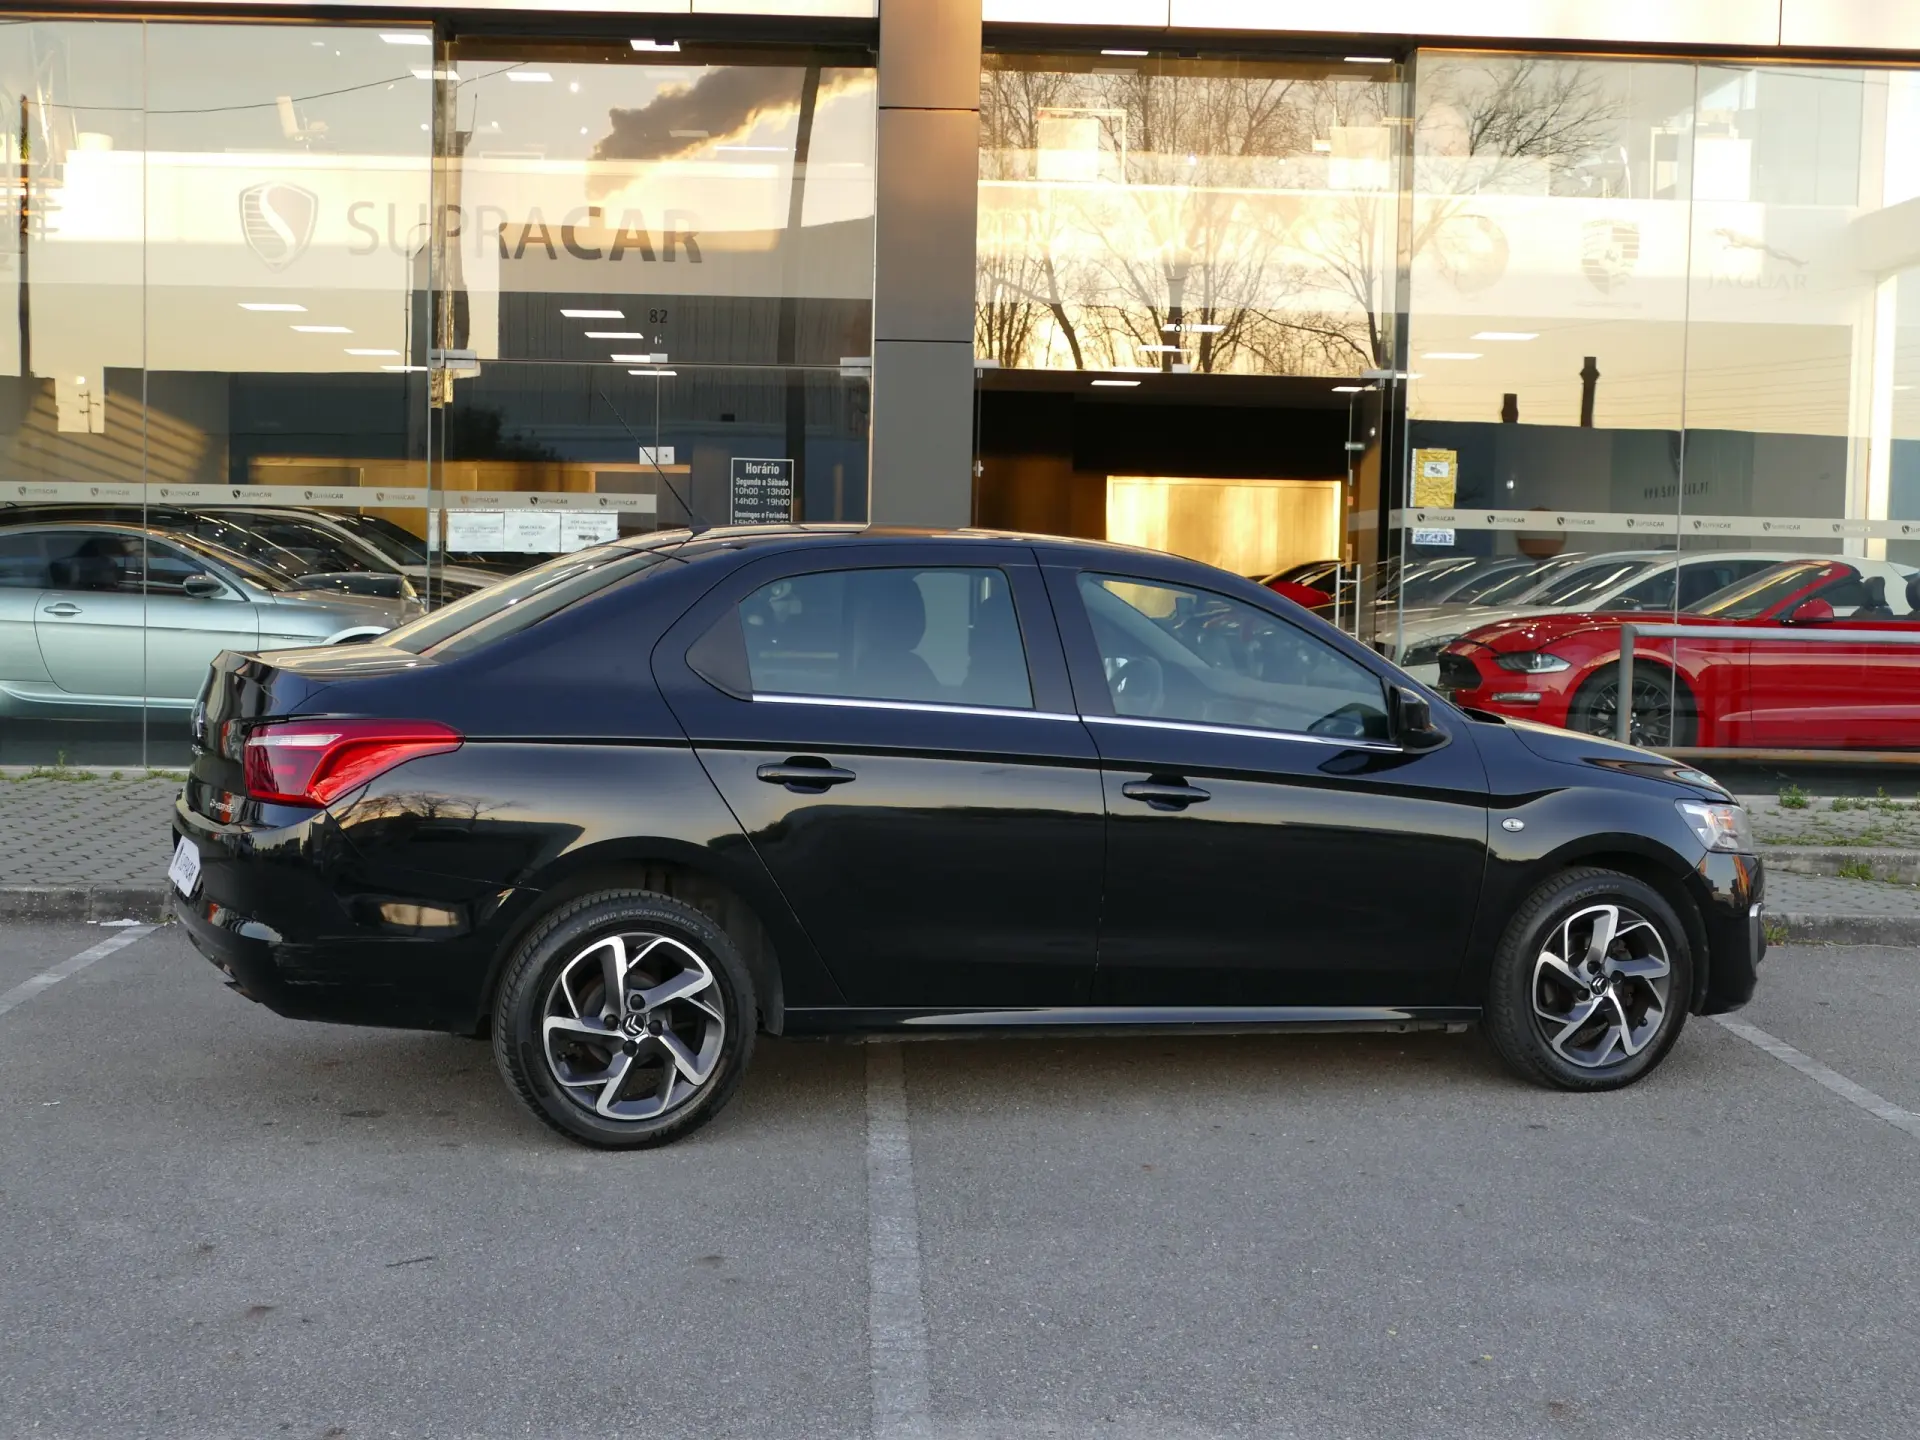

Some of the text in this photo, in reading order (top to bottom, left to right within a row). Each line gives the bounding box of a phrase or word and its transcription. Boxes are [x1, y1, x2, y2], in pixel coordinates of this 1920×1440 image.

[347, 200, 703, 263] SUPRACAR
[1706, 270, 1808, 291] JAGUAR
[649, 309, 668, 324] 82
[745, 462, 780, 474] Horário
[735, 477, 761, 487] Segunda
[767, 477, 789, 487] Sábado
[735, 487, 758, 495] 10h00
[766, 488, 790, 496] 13h00
[735, 497, 758, 505] 14h00
[766, 498, 790, 506] 19h00
[588, 909, 700, 931] ROAD PERFORMANCE
